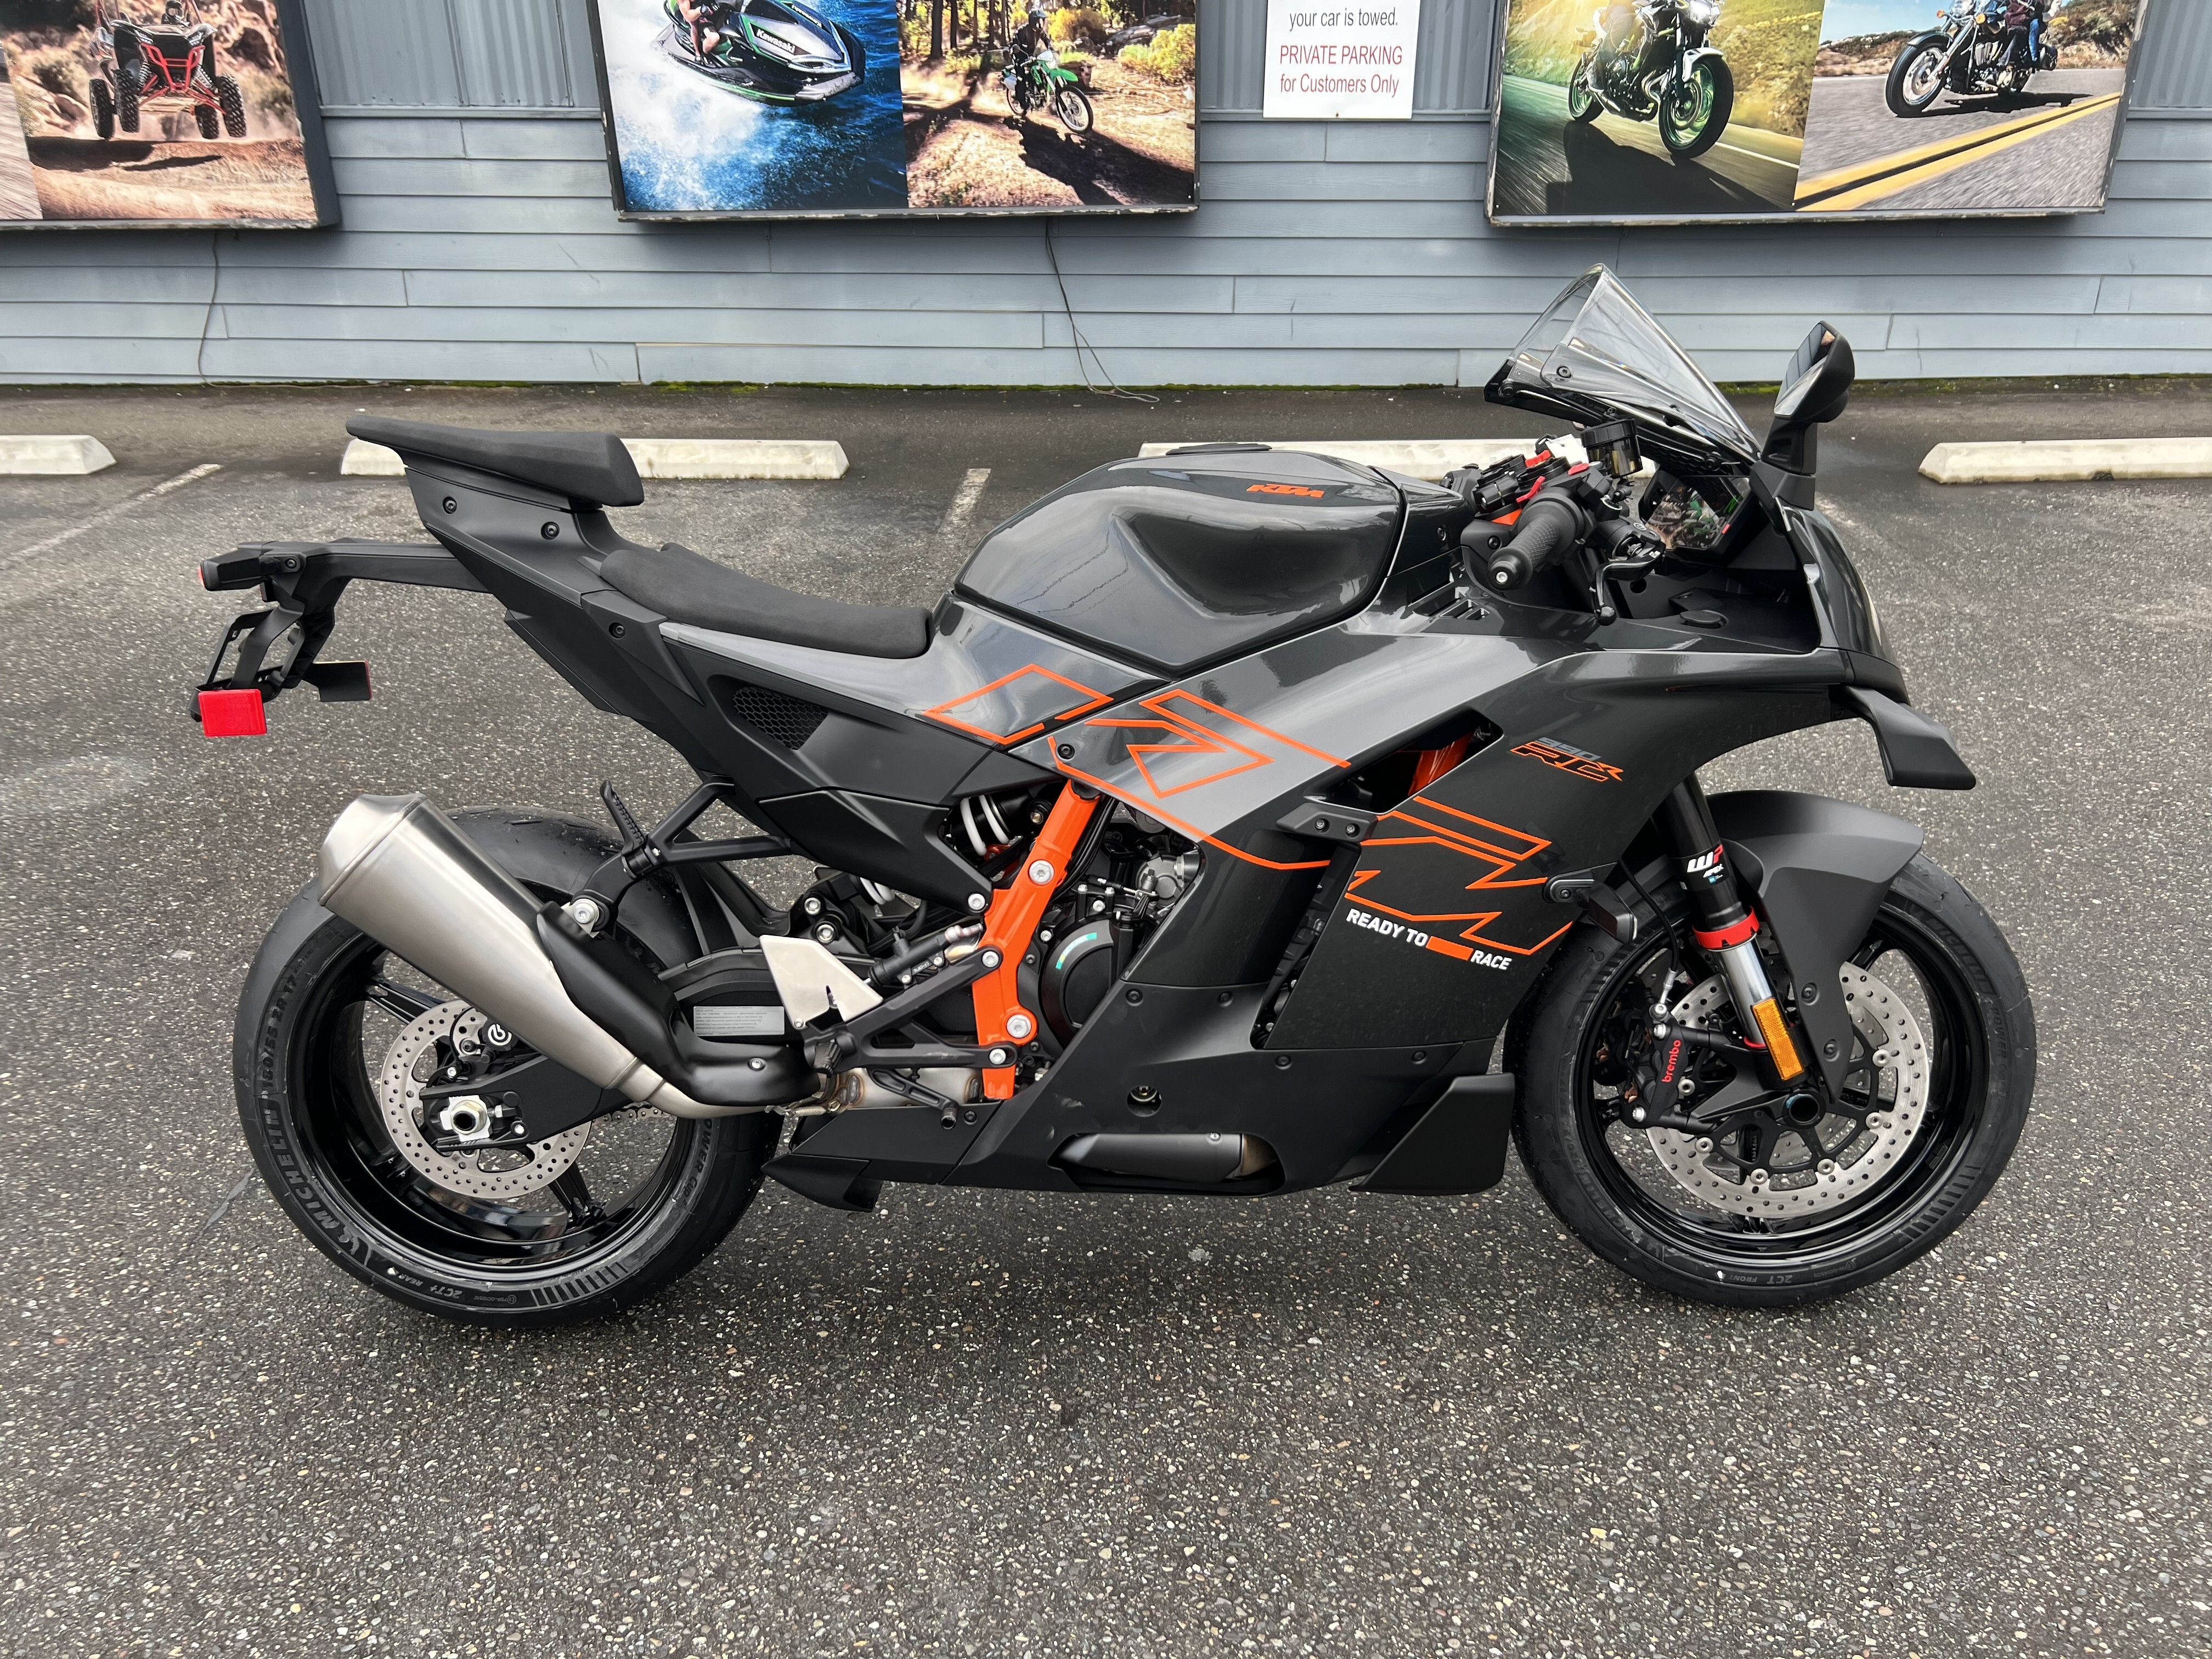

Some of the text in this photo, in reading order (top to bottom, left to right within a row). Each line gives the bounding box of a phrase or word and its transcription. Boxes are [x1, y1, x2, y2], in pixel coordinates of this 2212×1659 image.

[1290, 7, 1398, 32] your car is towed.
[756, 29, 795, 54] Kawasaki
[1280, 45, 1402, 65] PRIVATE PARKING
[1280, 73, 1400, 98] for Customers Only
[1246, 483, 1325, 498] KTM
[1535, 737, 1602, 761] 990
[1346, 908, 1513, 970] READY TO RACE
[1661, 1039, 1681, 1083] brembo
[695, 1119, 713, 1173] OWER
[263, 1108, 340, 1229] MICHELIN
[398, 1273, 424, 1287] REAR
[1729, 1274, 1758, 1283] FRONT
[1767, 1274, 1793, 1284] 2CT
